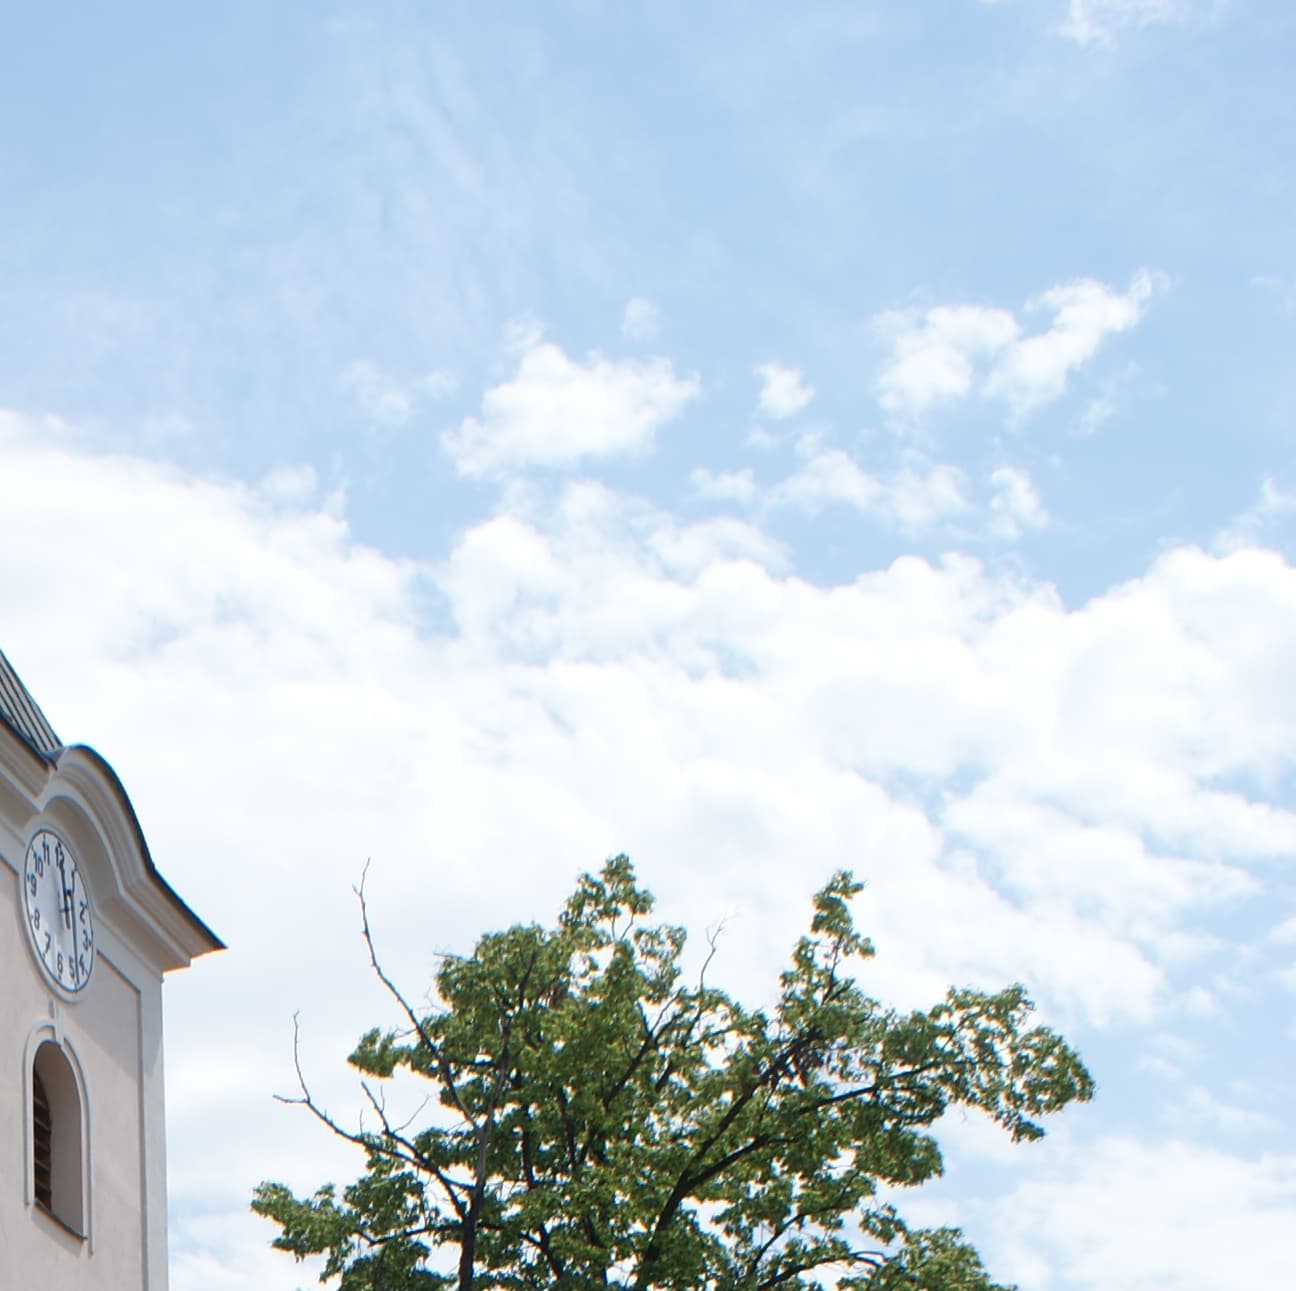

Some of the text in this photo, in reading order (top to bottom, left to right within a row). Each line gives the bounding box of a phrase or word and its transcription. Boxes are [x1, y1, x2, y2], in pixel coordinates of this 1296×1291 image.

[33, 851, 44, 878] 10
[42, 840, 50, 866] 11
[30, 873, 37, 897] 9
[34, 908, 40, 930] 8
[44, 931, 51, 954] 7
[82, 930, 89, 950] 3
[57, 952, 63, 976] 6
[69, 955, 76, 979] 5
